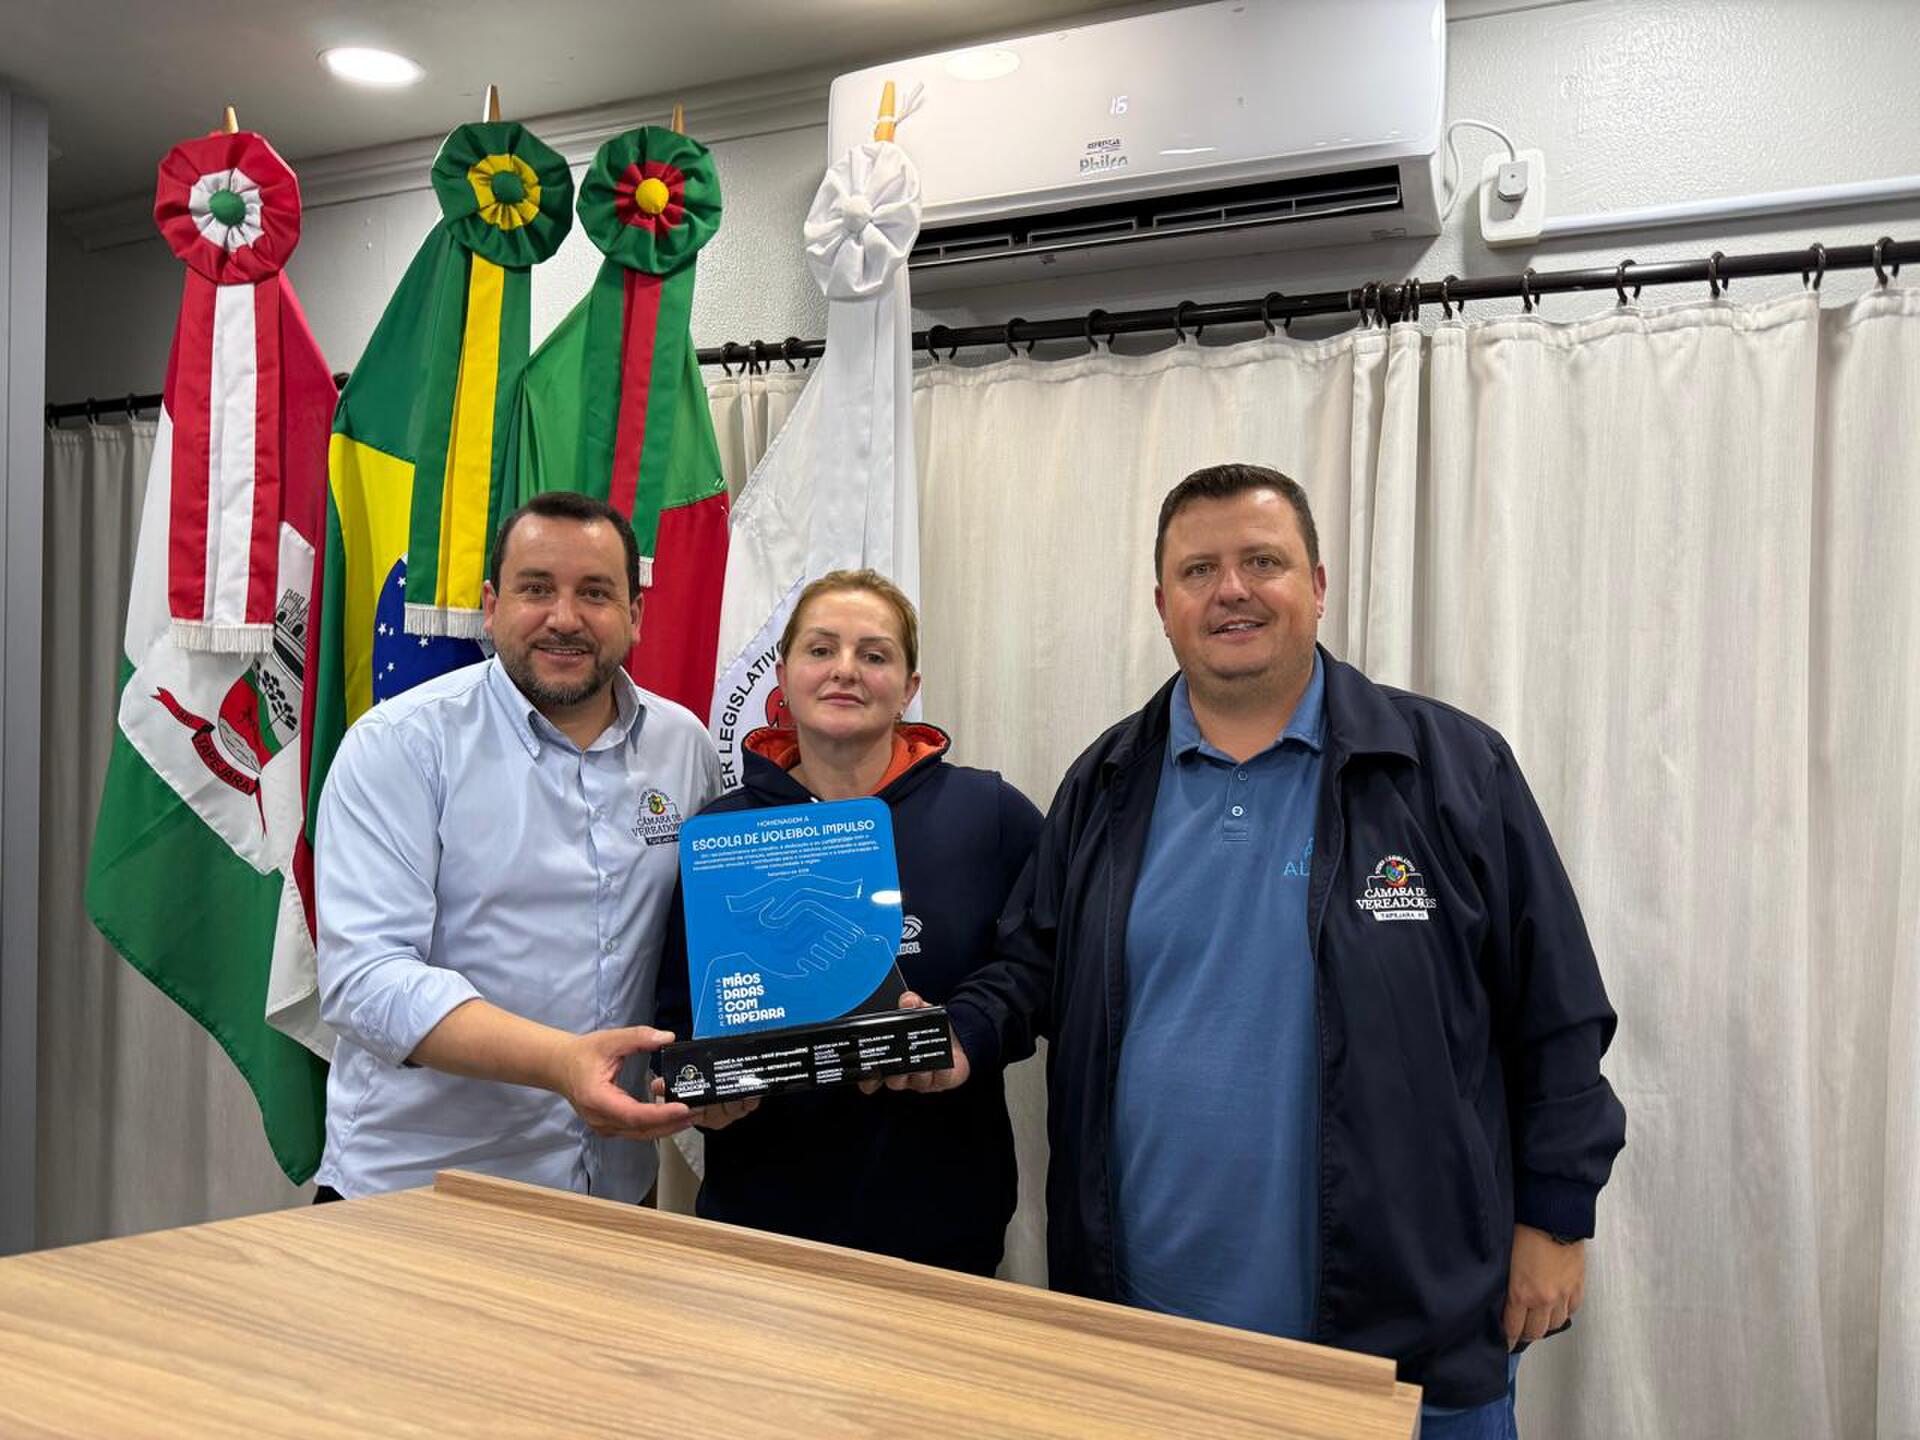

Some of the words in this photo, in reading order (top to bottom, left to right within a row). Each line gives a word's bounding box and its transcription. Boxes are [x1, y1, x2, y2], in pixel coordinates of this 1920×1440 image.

[720, 761, 738, 790] ER
[692, 835, 742, 852] ESCOLA
[744, 833, 760, 846] DE
[761, 826, 820, 844] VOLEIBOL
[822, 819, 876, 836] IMPULSO
[1283, 861, 1311, 876] AL
[1355, 897, 1437, 910] VEREADORES
[722, 972, 761, 988] MÃOS
[723, 984, 765, 1001] DADAS
[724, 997, 759, 1013] COM
[725, 1006, 786, 1026] TAPEJARA
